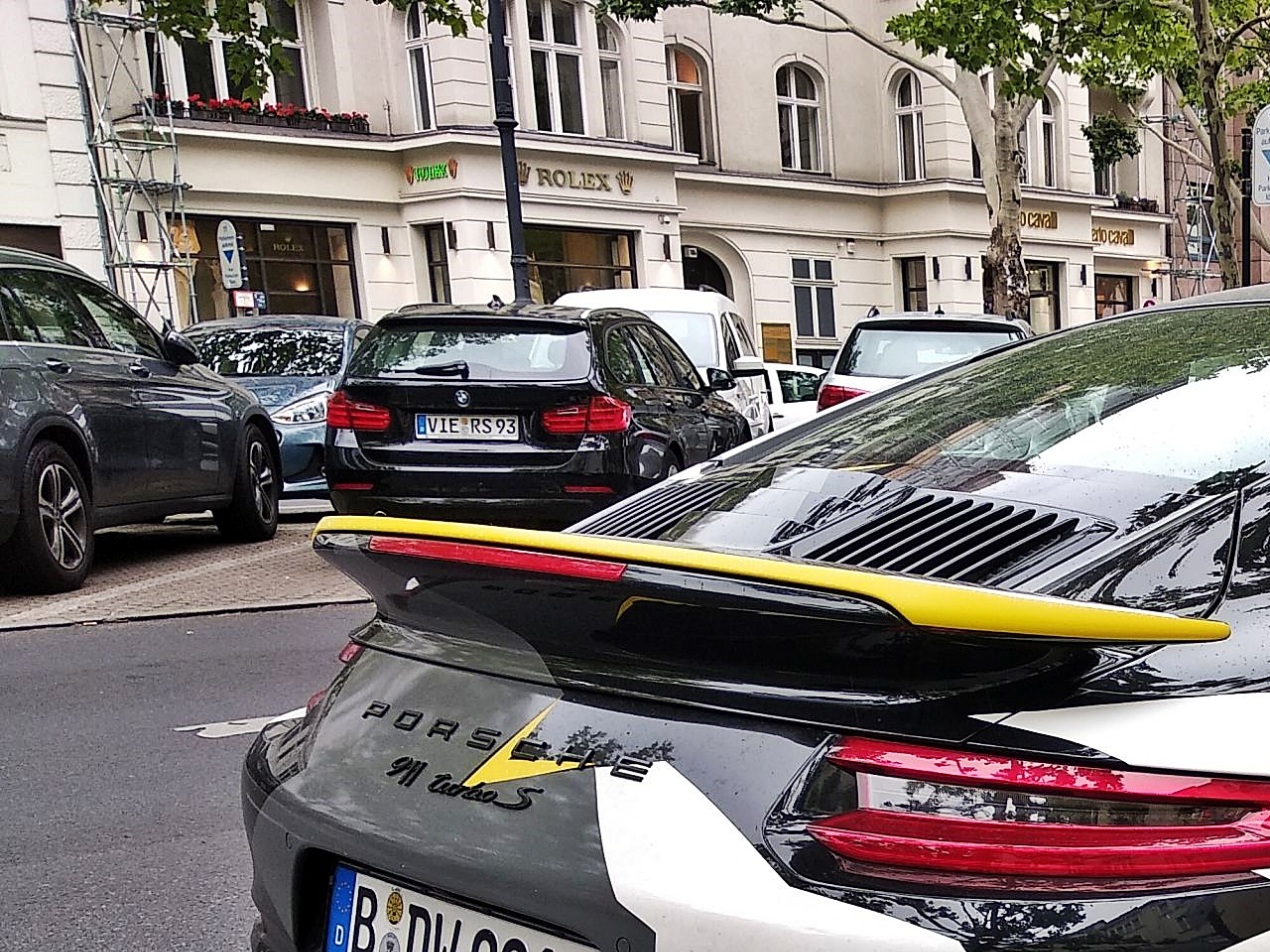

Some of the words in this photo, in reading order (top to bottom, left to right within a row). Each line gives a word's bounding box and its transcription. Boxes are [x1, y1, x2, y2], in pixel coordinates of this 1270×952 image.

[536, 168, 612, 192] ROLEX
[273, 243, 304, 252] ROLEX
[428, 418, 460, 434] VIE
[471, 418, 492, 434] RS
[496, 418, 516, 435] 93
[362, 700, 655, 783] PORSCHE
[386, 756, 428, 788] 911
[428, 773, 499, 803] turbo
[492, 787, 545, 811] S
